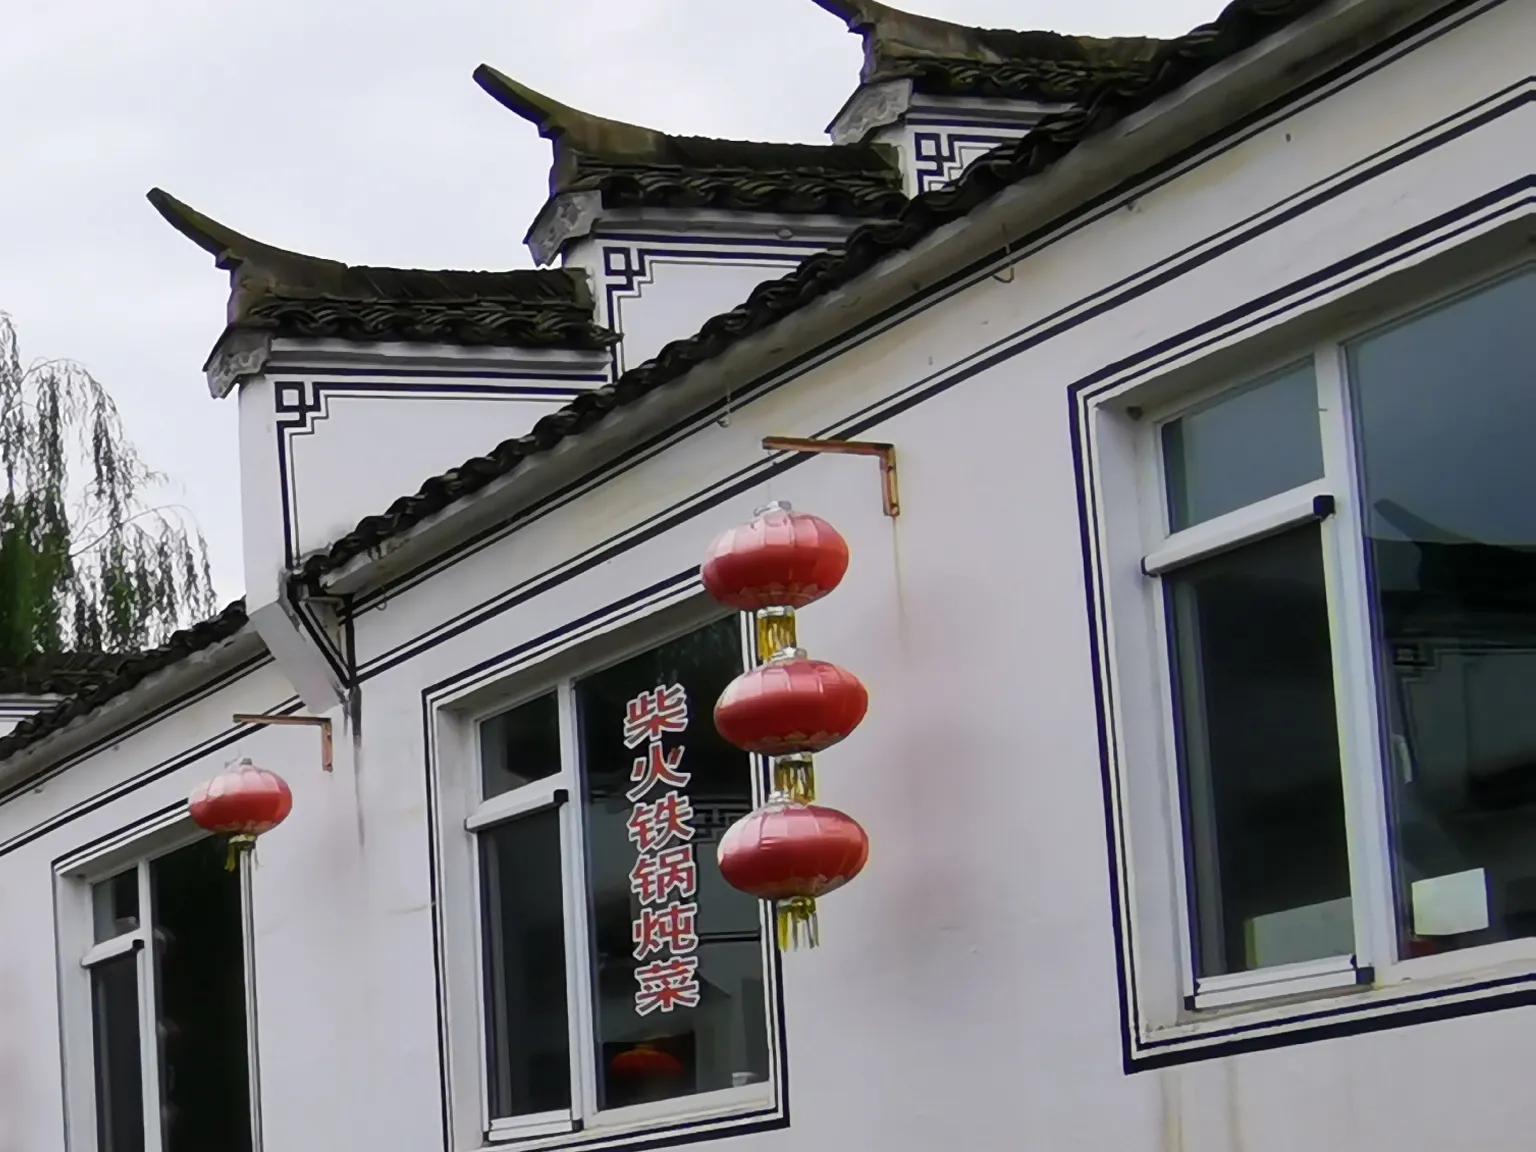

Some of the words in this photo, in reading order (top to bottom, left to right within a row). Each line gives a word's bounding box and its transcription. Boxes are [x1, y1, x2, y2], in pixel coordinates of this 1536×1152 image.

[623, 683, 700, 1016] 柴火铁锅炖菜
